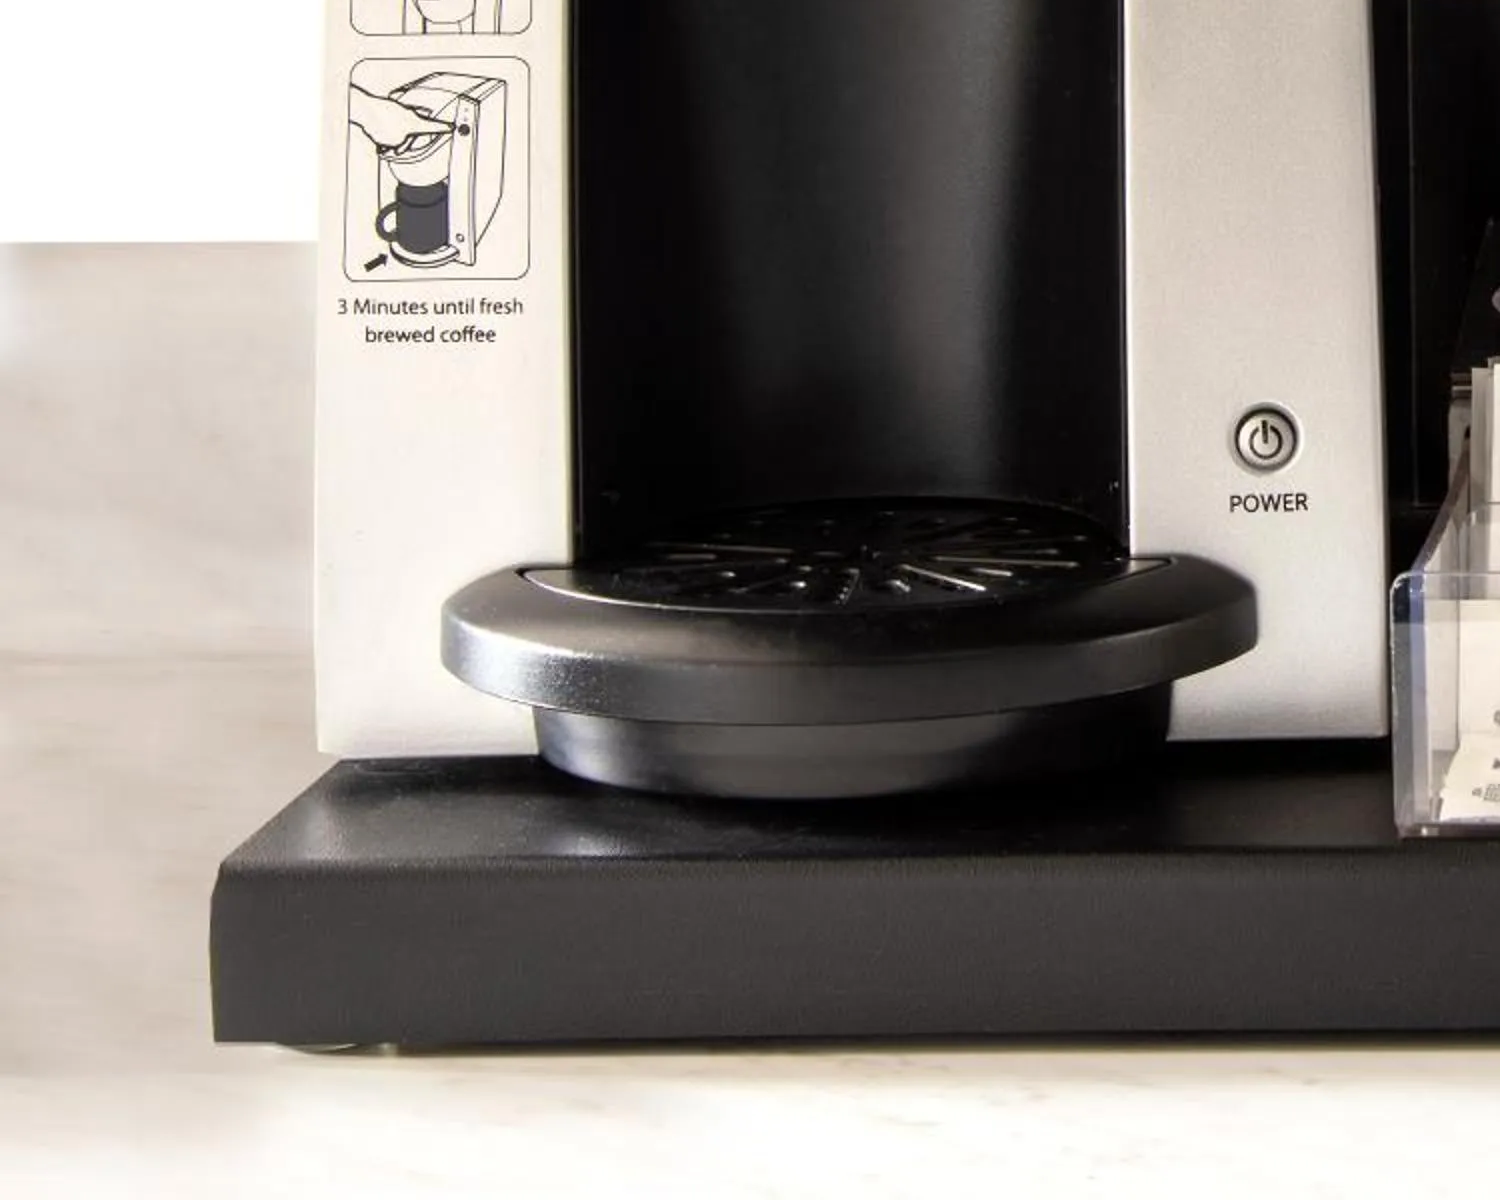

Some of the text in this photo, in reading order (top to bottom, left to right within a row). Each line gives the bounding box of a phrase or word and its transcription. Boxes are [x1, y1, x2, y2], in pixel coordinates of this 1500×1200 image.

[338, 297, 523, 315] 3 Minutes until fresh
[365, 325, 497, 342] brewed coffee
[1229, 493, 1309, 513] POWER
